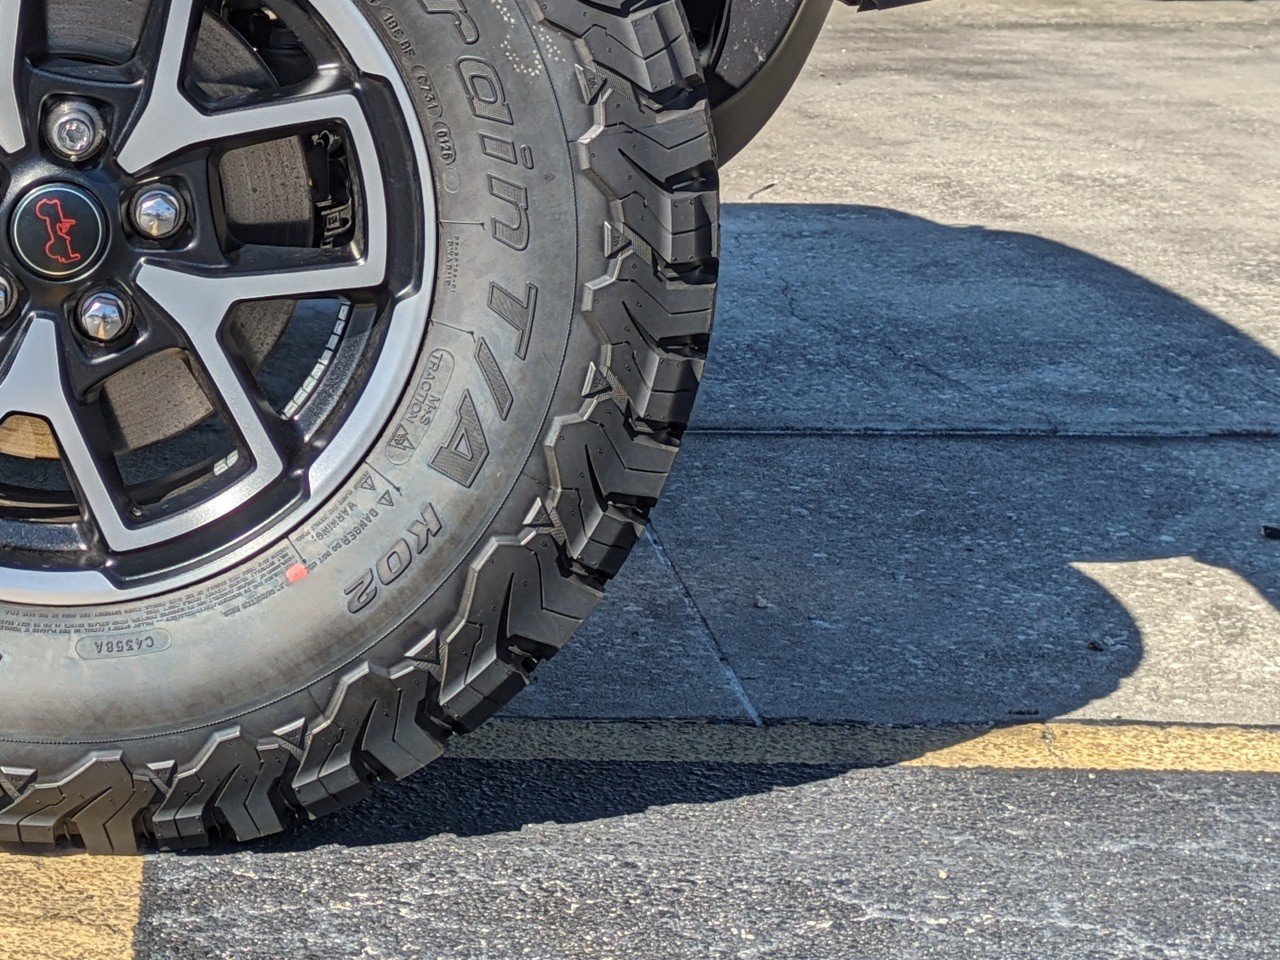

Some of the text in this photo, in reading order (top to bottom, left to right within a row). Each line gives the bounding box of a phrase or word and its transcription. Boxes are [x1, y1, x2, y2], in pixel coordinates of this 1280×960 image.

[437, 129, 453, 161] 0126
[406, 352, 443, 425] TRACTION
[343, 510, 379, 547] DANGER
